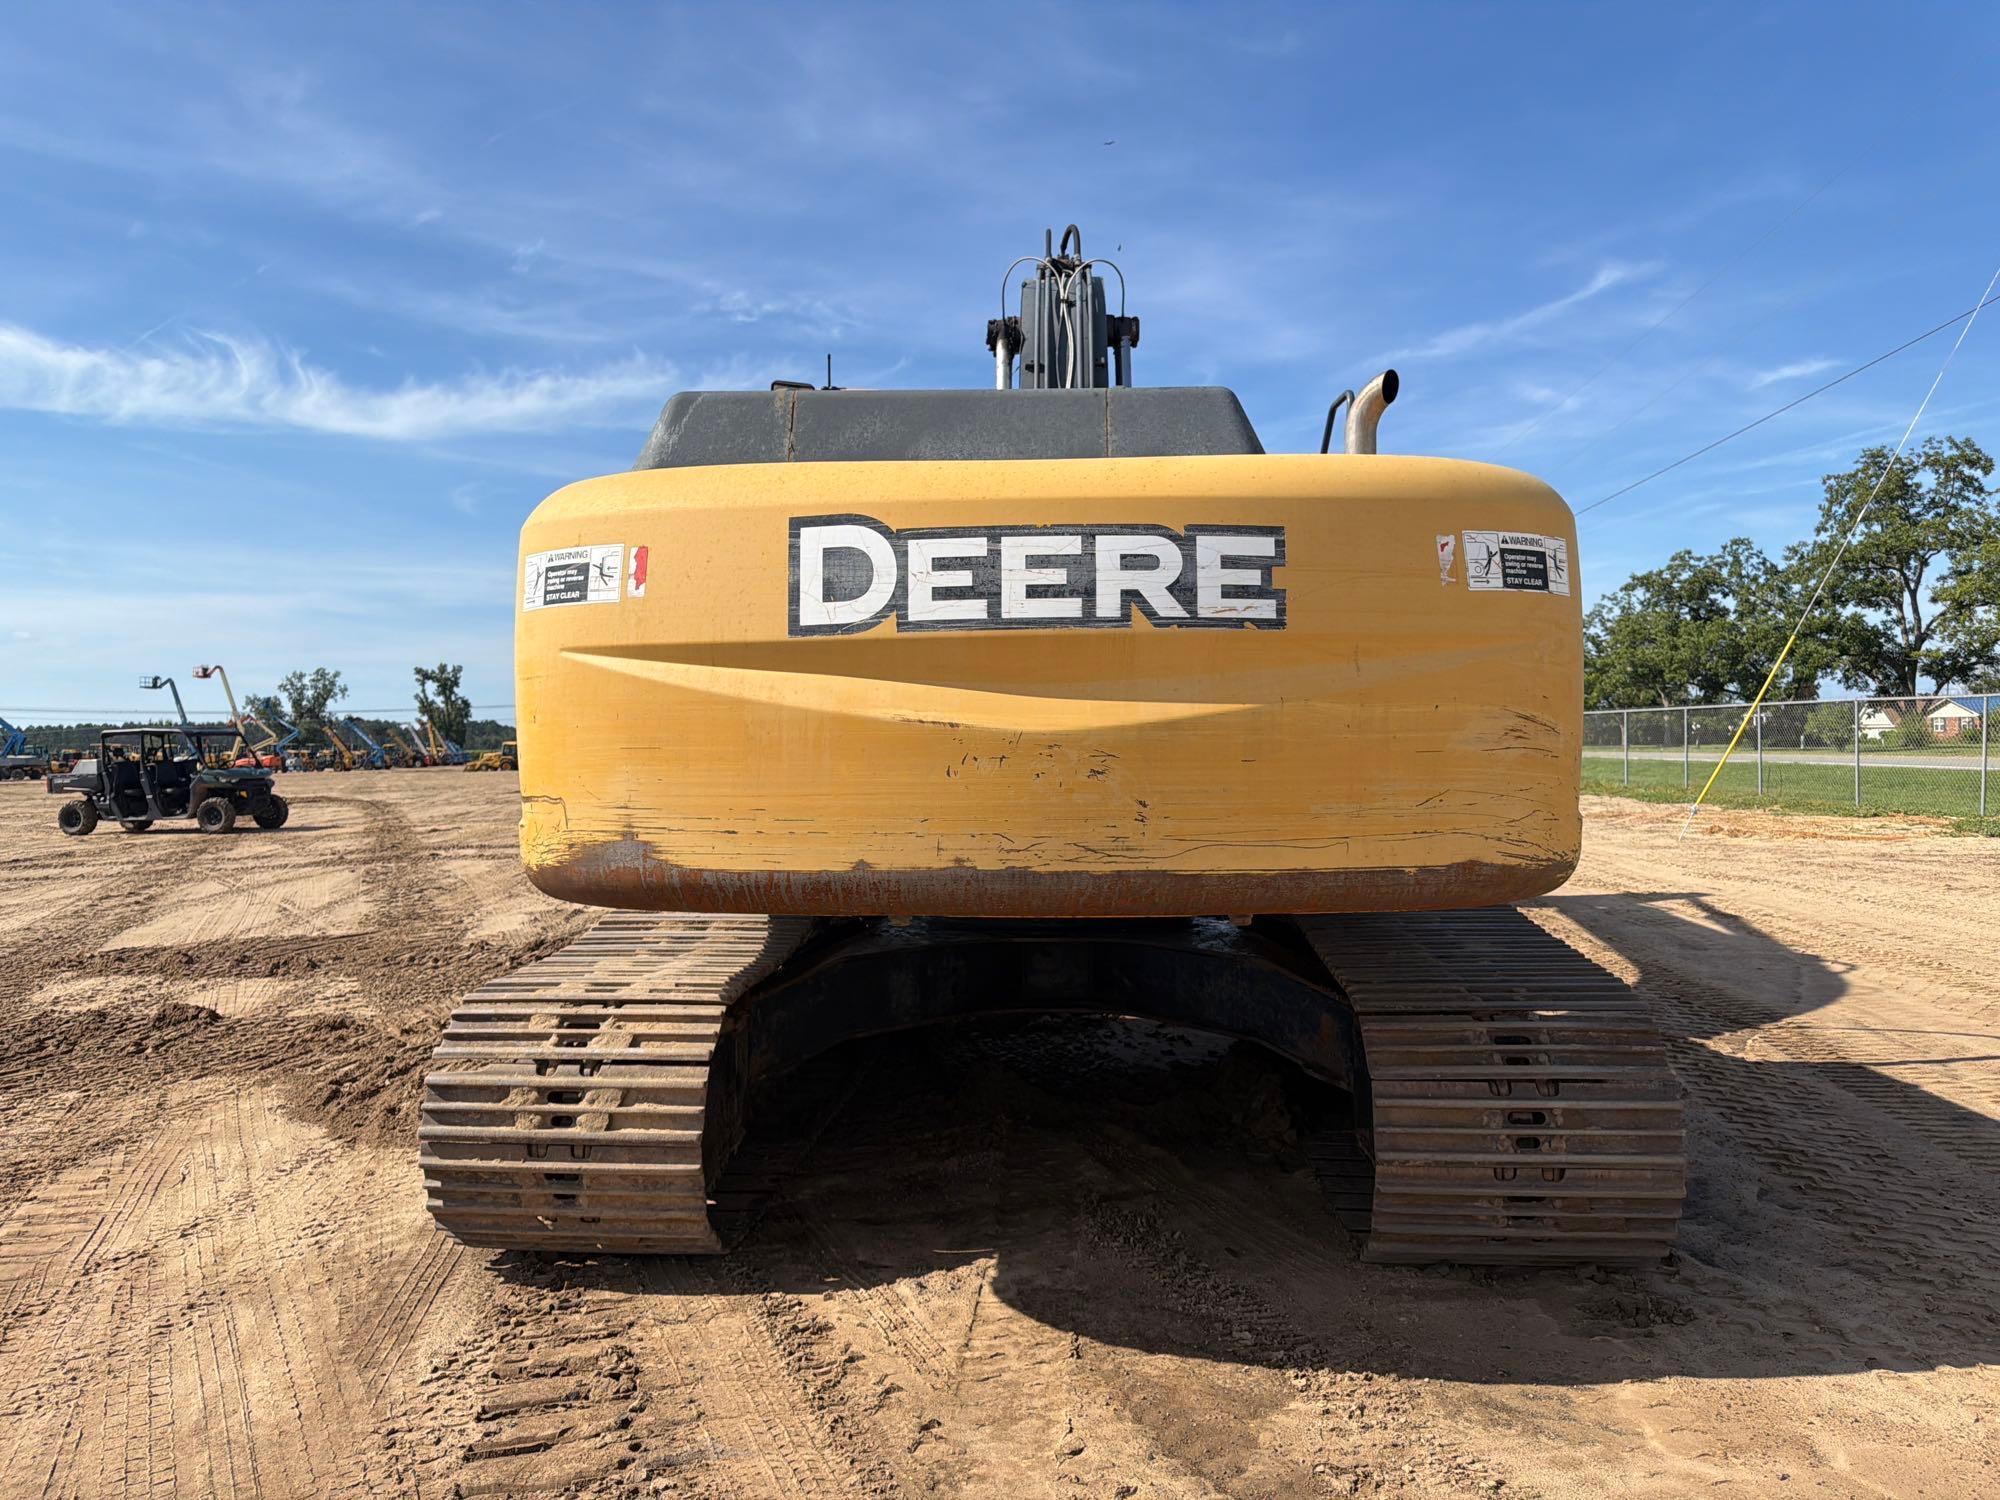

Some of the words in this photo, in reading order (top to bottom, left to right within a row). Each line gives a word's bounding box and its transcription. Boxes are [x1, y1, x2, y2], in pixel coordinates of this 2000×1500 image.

[1508, 536, 1544, 547] WARNING
[554, 550, 588, 562] WARNING
[1504, 554, 1526, 562] Operator
[547, 570, 567, 578] Operator
[799, 524, 1277, 626] DEERE
[1507, 577, 1523, 585] STAY
[1524, 578, 1543, 586] CLEAR
[546, 593, 560, 602] STAY
[560, 591, 580, 600] CLEAR
